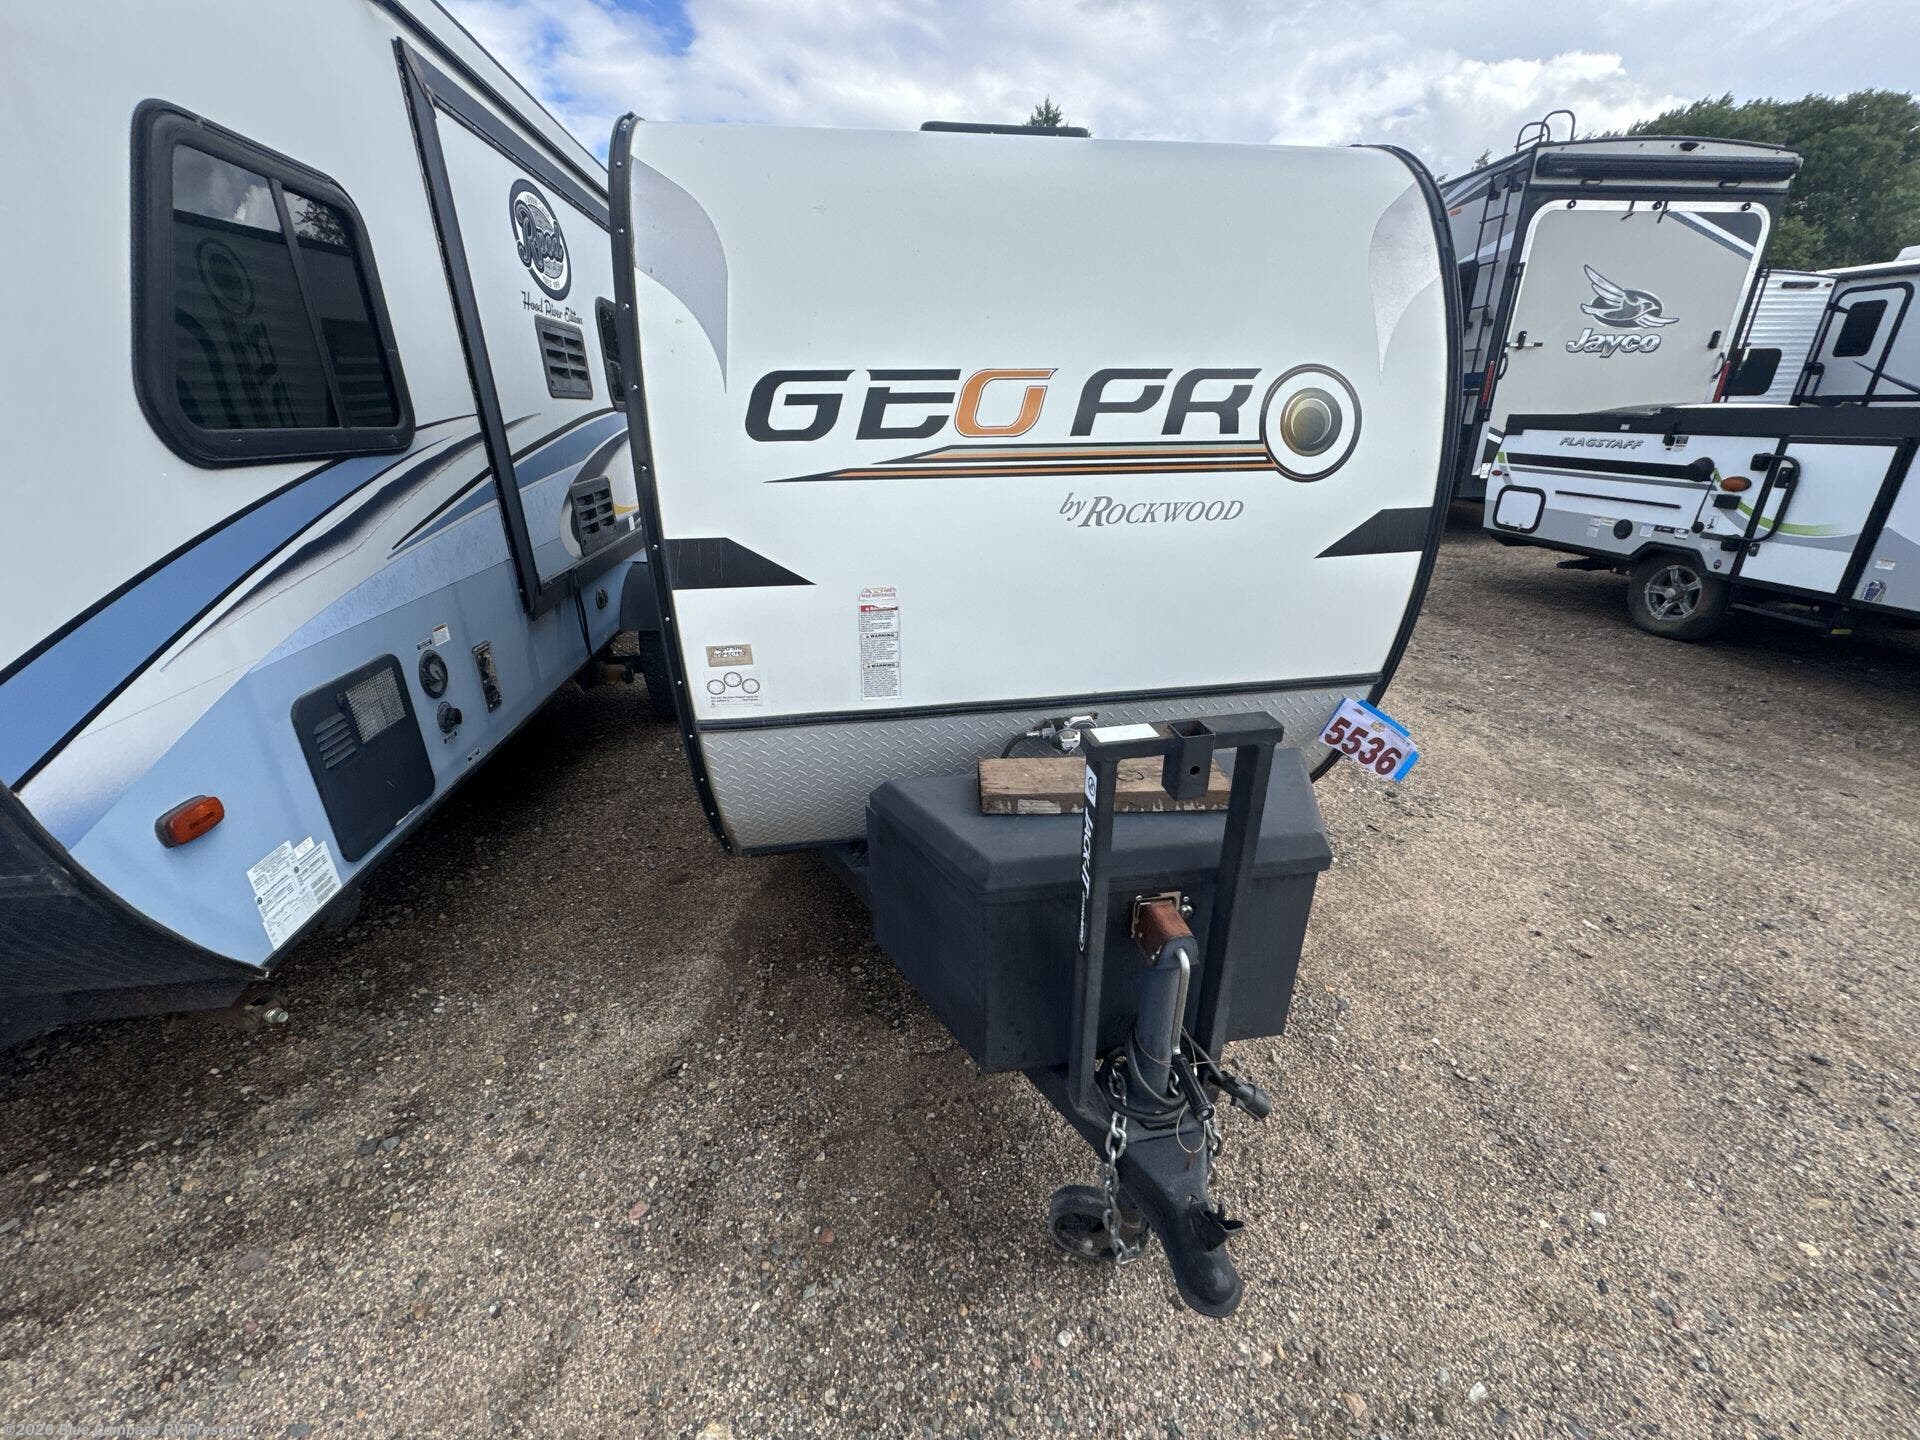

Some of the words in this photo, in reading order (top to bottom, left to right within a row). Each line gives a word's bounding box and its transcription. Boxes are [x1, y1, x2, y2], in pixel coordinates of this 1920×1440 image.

[521, 290, 543, 313] Hood
[544, 299, 563, 318] River
[564, 307, 583, 325] Edition
[1566, 328, 1661, 358] Jayco
[745, 368, 1059, 442] GEO
[1560, 437, 1644, 450] FLAGSTAFF
[1059, 492, 1087, 521] by
[1077, 496, 1244, 527] ROCKWOOD
[1325, 716, 1402, 775] 5536
